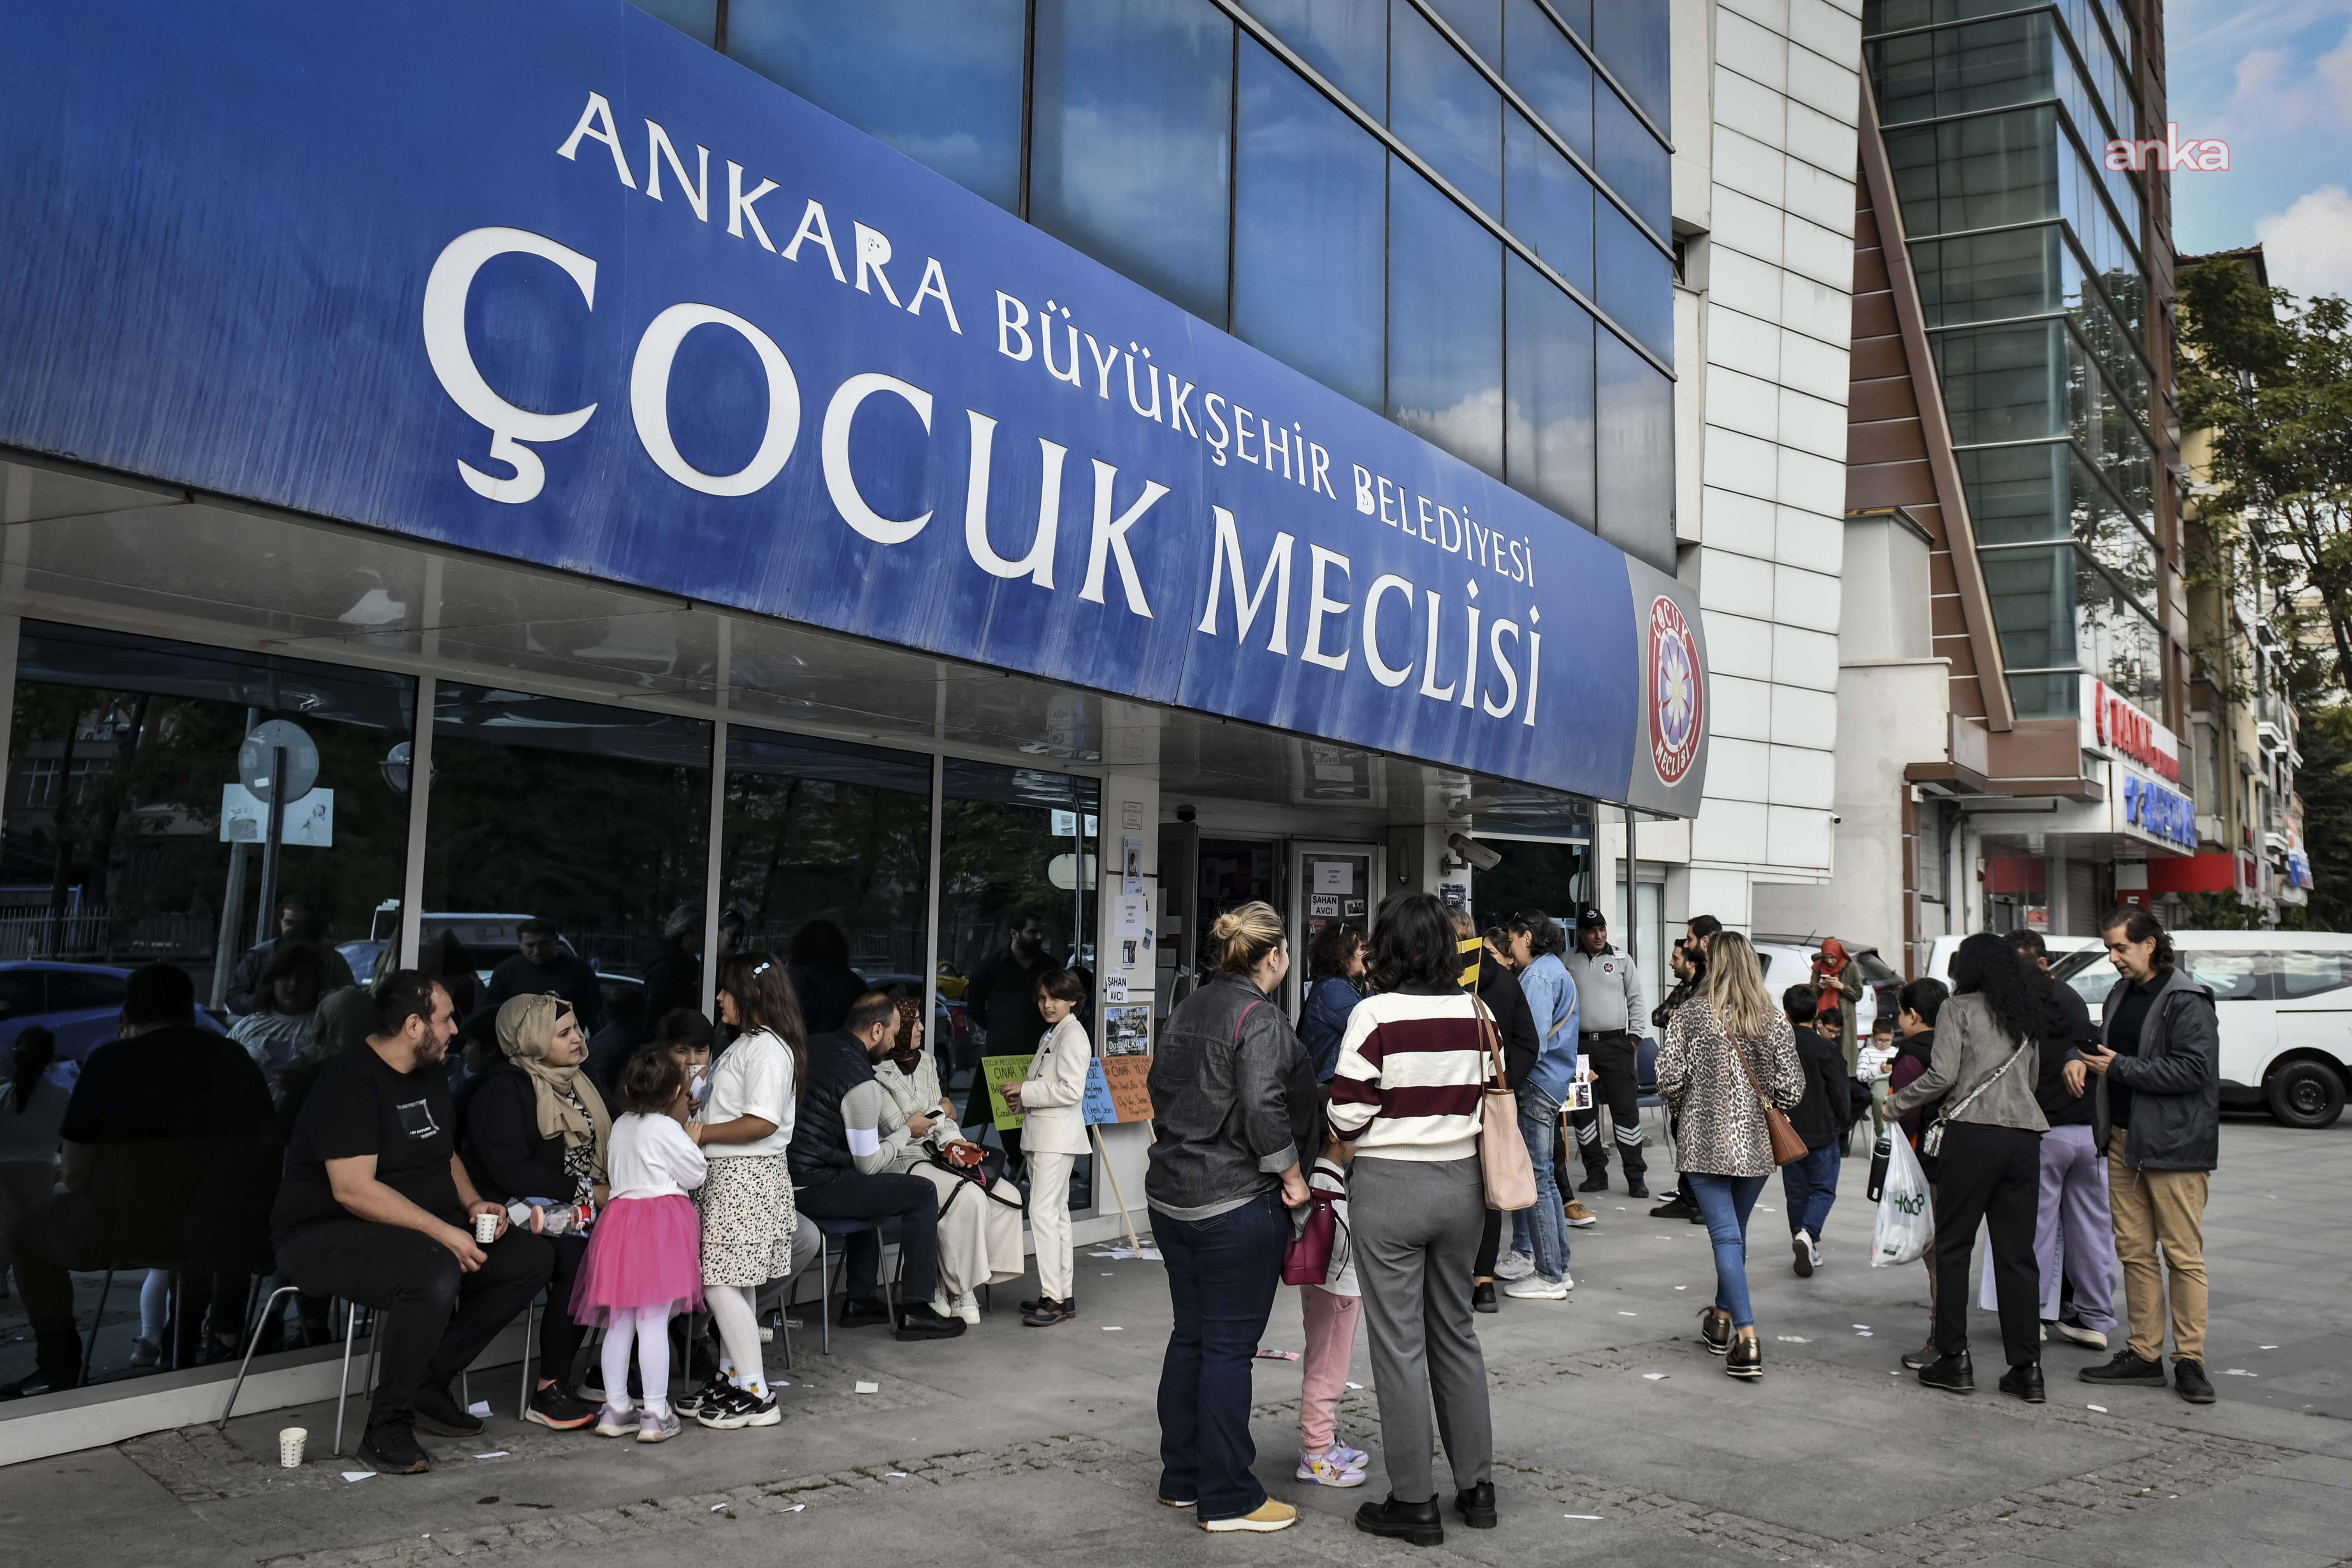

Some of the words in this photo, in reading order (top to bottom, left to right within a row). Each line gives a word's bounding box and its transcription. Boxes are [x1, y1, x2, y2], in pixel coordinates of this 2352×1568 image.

[557, 91, 963, 334] ANKARA
[996, 290, 1337, 500] BÜYÜKŞEHİR
[1353, 463, 1534, 588] BELEDİYESİ
[423, 227, 1171, 620] ÇOCUK
[1197, 504, 1541, 727] MECLİSİ
[1313, 896, 1337, 905] ŞAHAN
[1107, 977, 1126, 988] ŞAHAN
[1110, 992, 1123, 1001] AVCI
[1109, 1041, 1122, 1049] Dora
[1124, 1039, 1144, 1048] ALKAN
